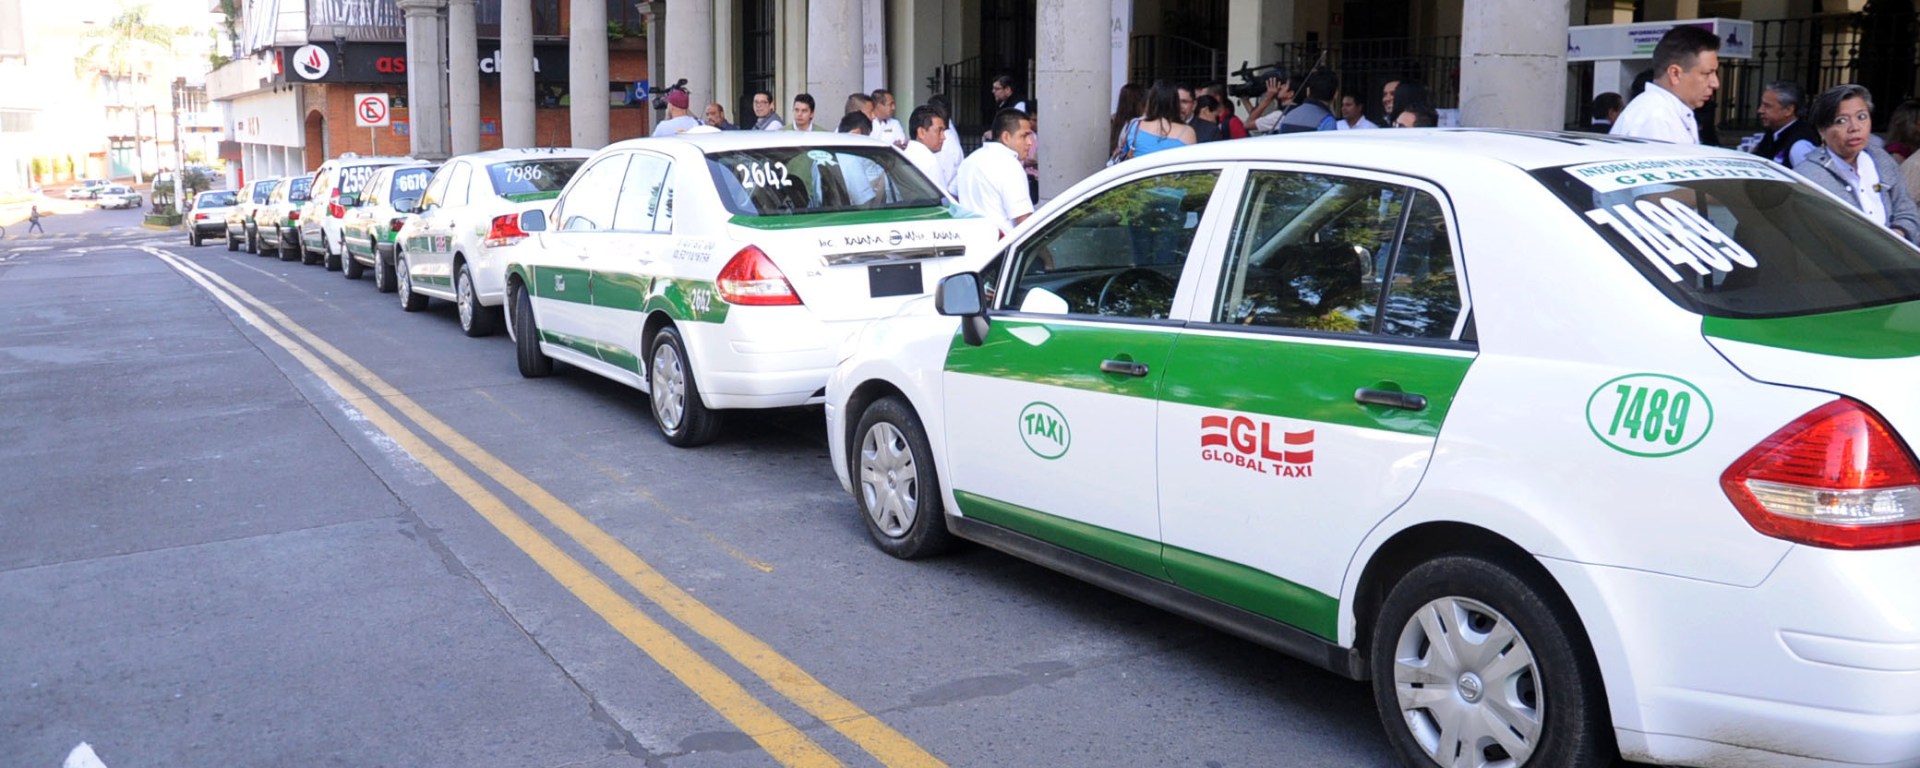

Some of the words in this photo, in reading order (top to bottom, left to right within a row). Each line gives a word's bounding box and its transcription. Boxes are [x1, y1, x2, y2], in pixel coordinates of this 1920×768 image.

[400, 172, 428, 192] 6678
[504, 164, 542, 183] 7986
[736, 161, 793, 190] 2642
[1615, 168, 1776, 185] GRATUITA
[1584, 197, 1759, 283] 7489
[1024, 412, 1064, 446] TAXI
[1608, 384, 1692, 446] 7489
[1201, 448, 1267, 474] GLOBAL
[1272, 464, 1313, 478] TAXI
